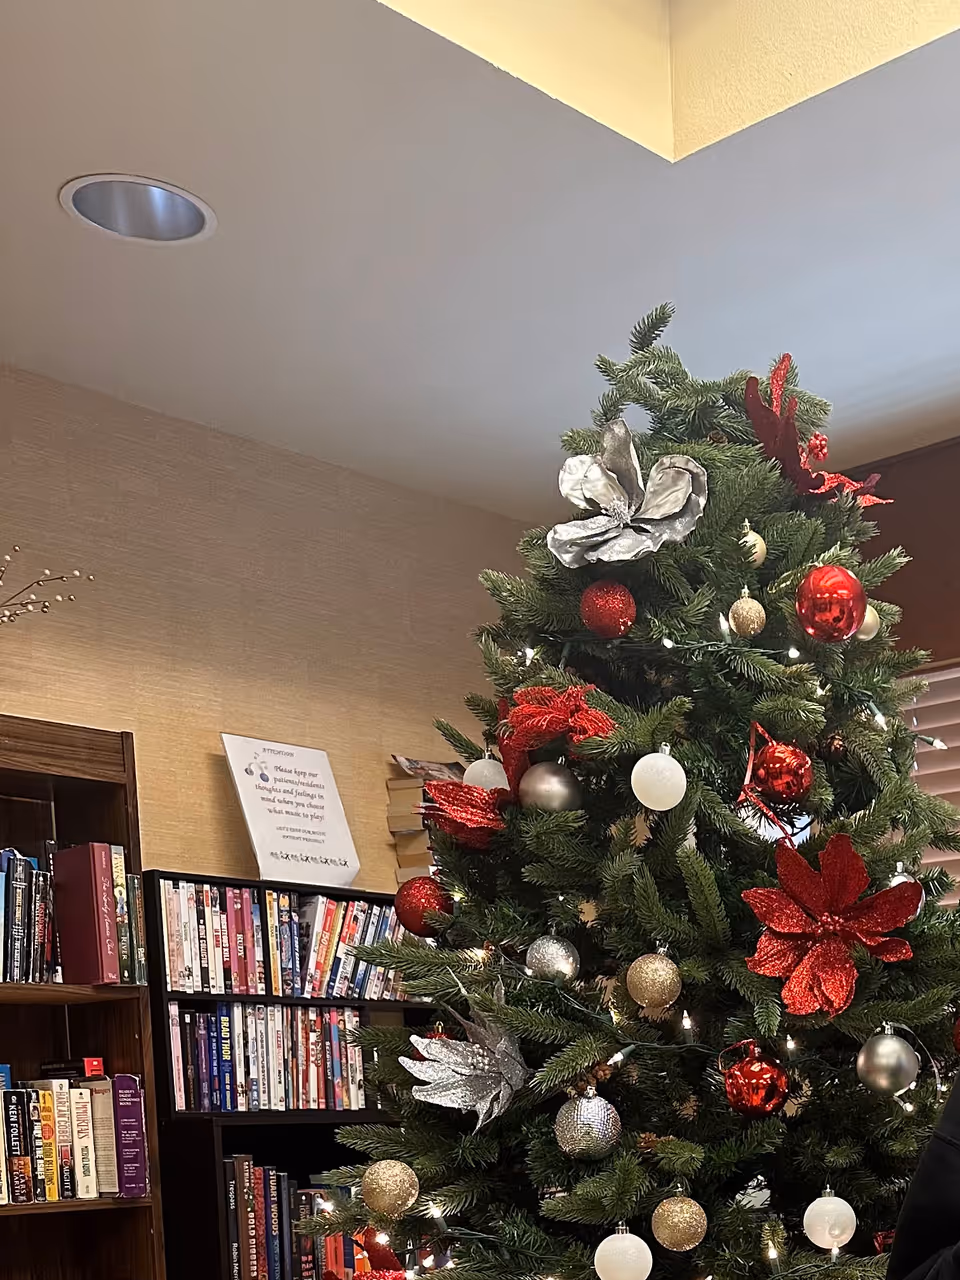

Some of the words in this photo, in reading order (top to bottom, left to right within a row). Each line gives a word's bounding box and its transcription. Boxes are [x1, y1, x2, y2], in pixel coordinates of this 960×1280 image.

[274, 765, 292, 774] Please
[294, 769, 307, 778] keep
[255, 784, 281, 794] thoughts
[294, 789, 316, 800] feelings
[267, 807, 284, 815] what
[285, 809, 301, 817] music
[277, 797, 293, 806] when
[294, 801, 305, 809] you
[306, 801, 324, 810] choose
[221, 1016, 230, 1038] BRAD
[222, 1039, 230, 1060] THOR
[9, 1105, 17, 1121] KEN
[56, 1091, 69, 1118] HARLAN
[10, 1123, 20, 1155] FOLLETT
[18, 1160, 26, 1194] PILLARS
[37, 1160, 45, 1179] ASHES
[271, 1204, 279, 1235] WOODS
[249, 1239, 257, 1277] DIGGERS
